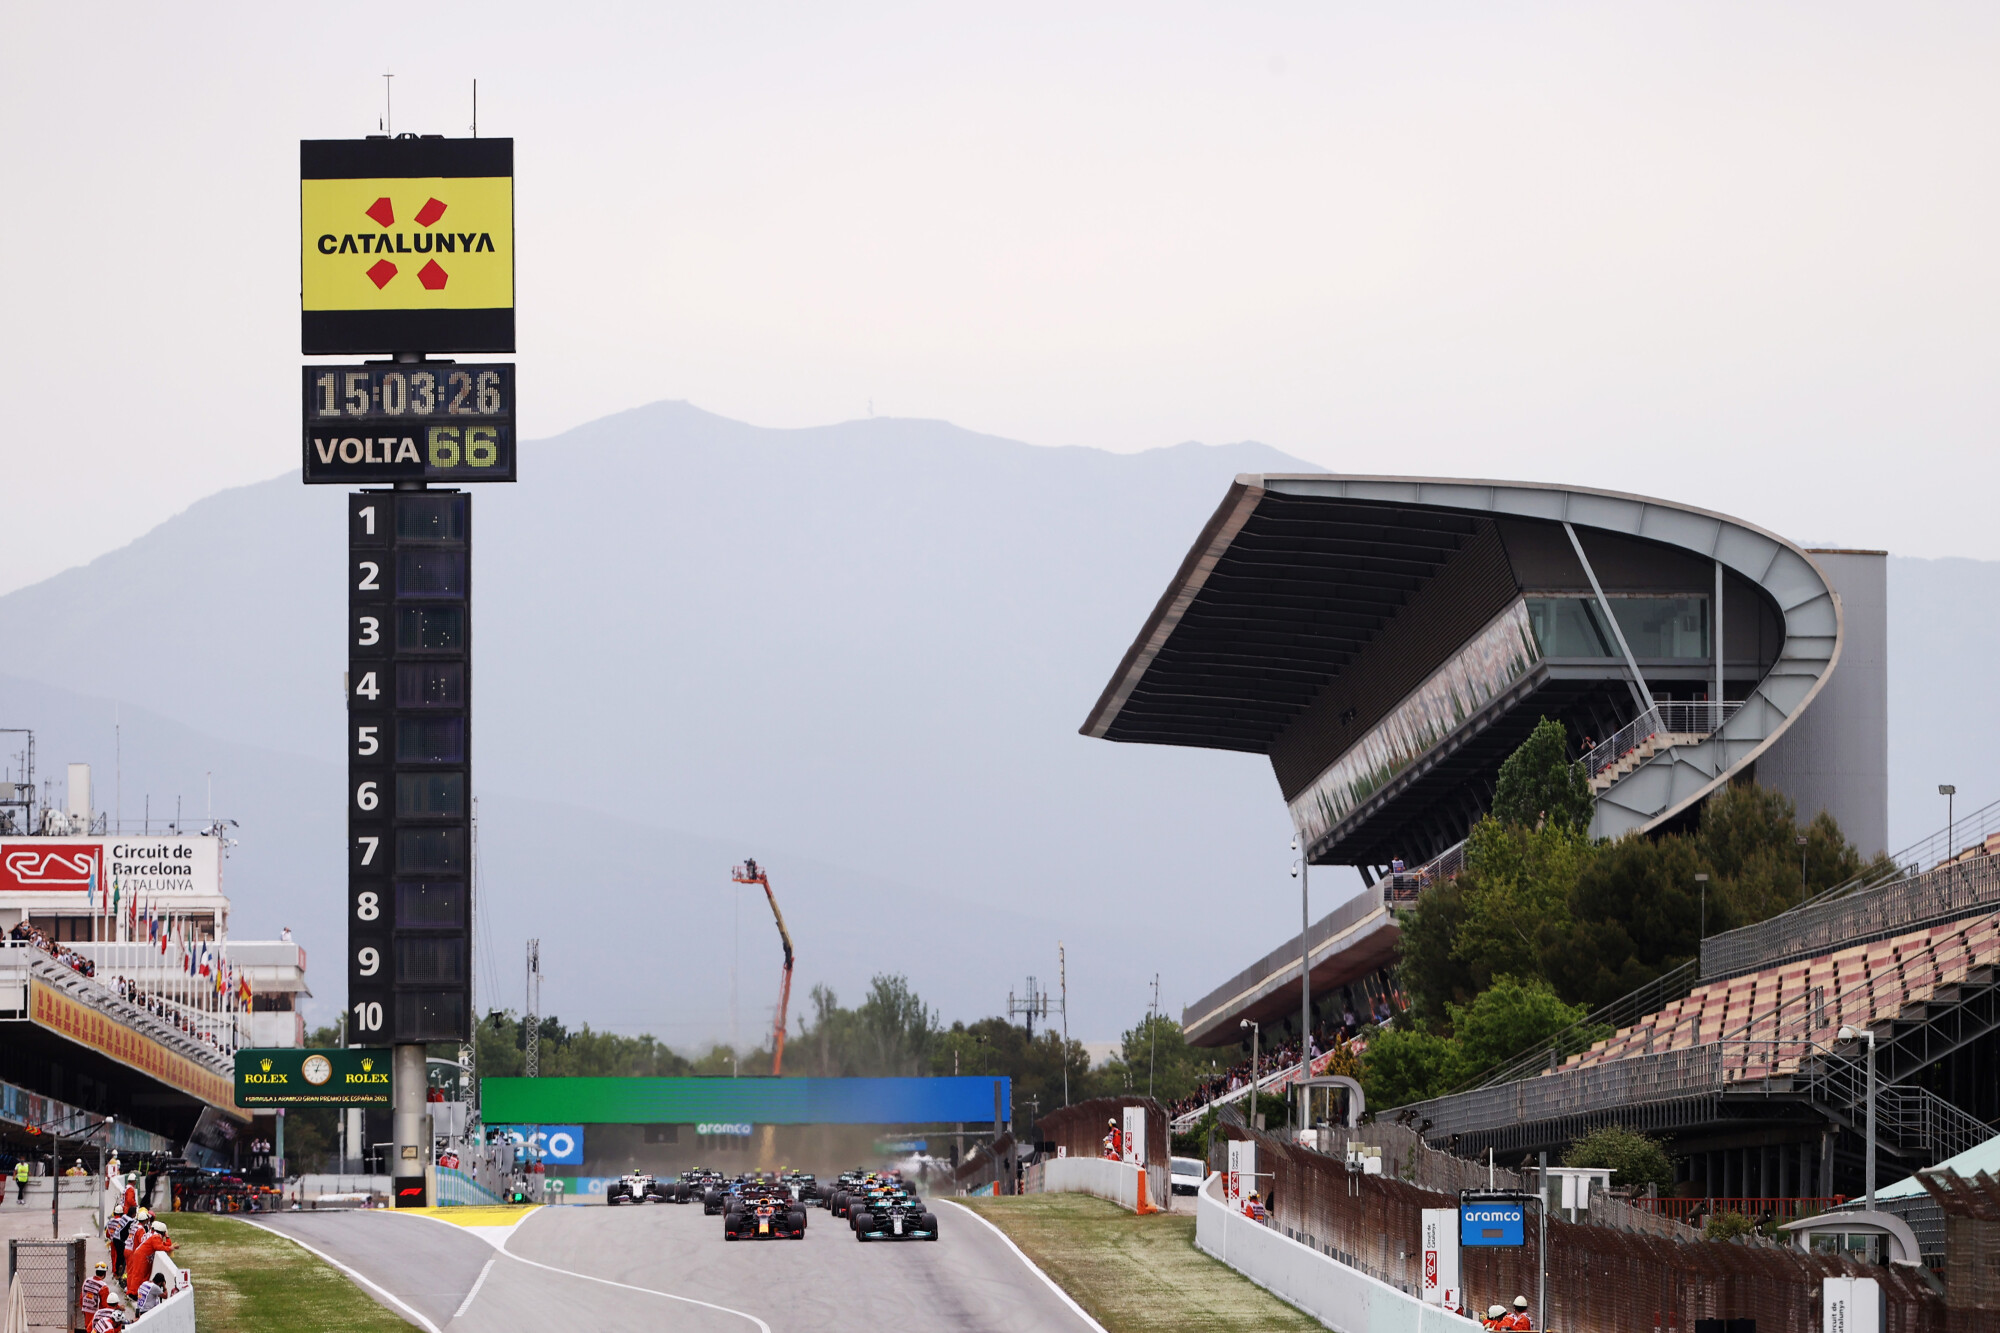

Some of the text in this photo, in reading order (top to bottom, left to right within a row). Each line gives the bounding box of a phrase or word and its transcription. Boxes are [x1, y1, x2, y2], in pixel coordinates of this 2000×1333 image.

[317, 233, 495, 255] CATALUNYA
[316, 371, 500, 417] 15:03:26
[314, 426, 497, 468] VOLTA 66
[358, 506, 375, 535] 1
[358, 561, 380, 590] 2
[358, 616, 380, 646] 3
[356, 671, 380, 700] 4
[358, 726, 379, 756] 5
[356, 781, 379, 811] 6
[113, 844, 192, 859] Circuit de
[358, 836, 379, 866] 7
[113, 862, 192, 875] Barcelona
[357, 891, 380, 921] 8
[357, 946, 380, 977] 9
[353, 1001, 383, 1031] 10
[244, 1074, 288, 1084] ROLEX
[345, 1074, 389, 1084] ROLEX
[697, 1123, 750, 1134] aramco
[1465, 1212, 1520, 1222] aramco
[1831, 1302, 1836, 1311] de
